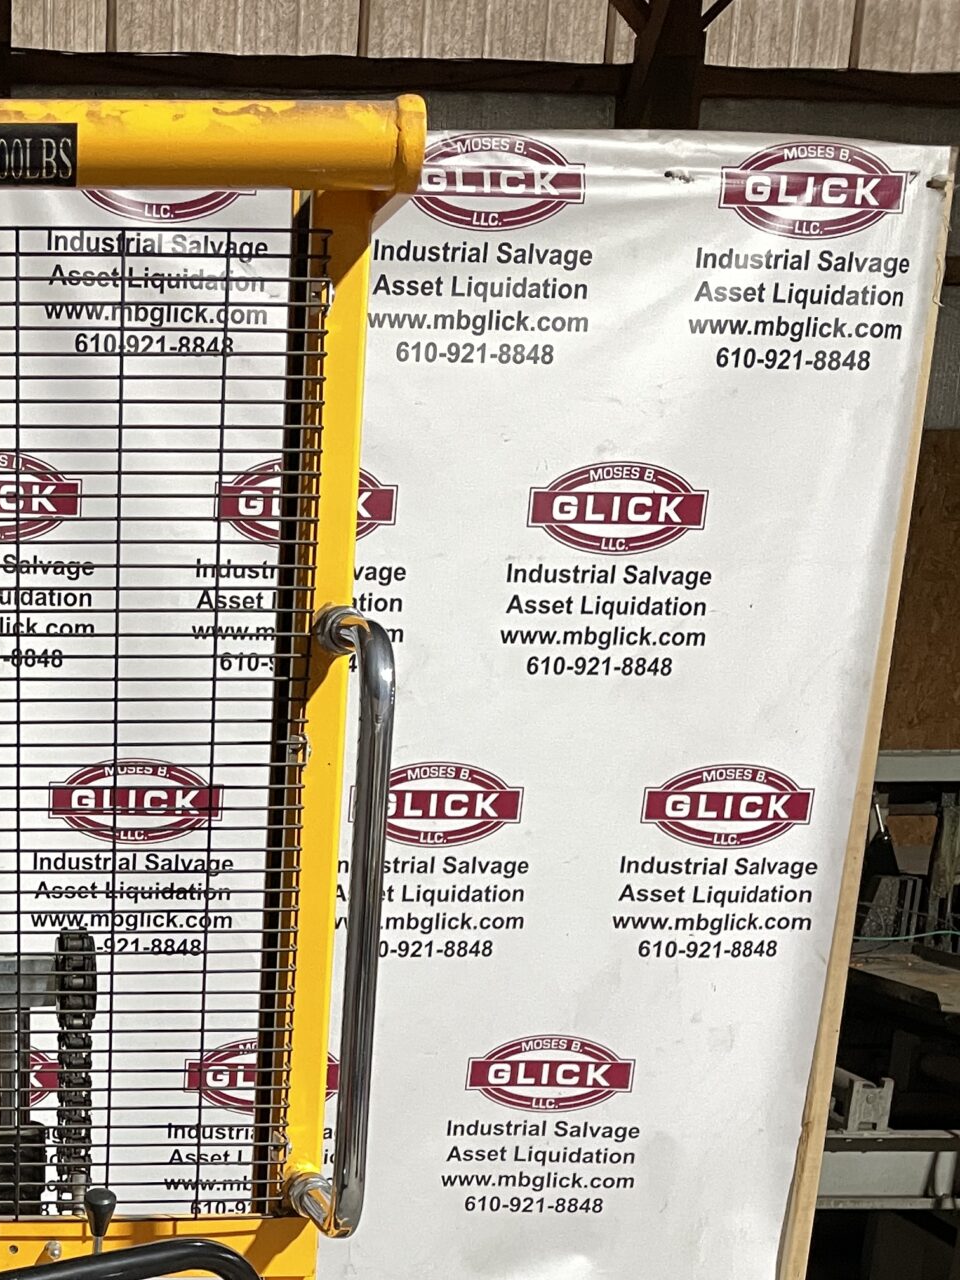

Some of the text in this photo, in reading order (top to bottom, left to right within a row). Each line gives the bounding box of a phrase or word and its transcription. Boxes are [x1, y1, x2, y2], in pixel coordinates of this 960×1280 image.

[458, 137, 510, 152] MOSES
[783, 146, 835, 161] MOSES
[420, 167, 559, 197] GLICK
[744, 175, 881, 206] GLICK
[144, 204, 174, 217] LLC.
[472, 213, 501, 226] LLC.
[794, 221, 823, 234] LLC.
[373, 240, 592, 271] Industrial Salvage
[696, 248, 909, 278] Industrial Salvage
[373, 274, 587, 302] Asset Liquidation
[695, 281, 903, 309] Asset Liquidation
[368, 310, 588, 336] www.mbglick.com
[689, 316, 902, 342] www.mbglick.com
[397, 342, 553, 364] 610-921-8848
[717, 347, 870, 370] 610-921-8848
[590, 467, 639, 481] MOSES
[552, 495, 684, 523] GLICK
[600, 538, 628, 550] LLC.
[507, 563, 711, 590] Industrial Salvage
[506, 595, 706, 620] Asset Liquidation
[501, 626, 705, 650] www.mbglick.com
[527, 656, 672, 676] 610-921-8848
[407, 767, 455, 780] MOSES
[703, 769, 751, 781] MOSES
[71, 789, 199, 815] GLICK
[666, 793, 792, 820] GLICK
[420, 832, 447, 842] LLC.
[712, 833, 739, 844] LLC.
[443, 856, 528, 878] Salvage
[620, 856, 817, 879] Industrial Salvage
[402, 885, 524, 906] Liquidation
[618, 884, 812, 907] Asset Liquidation
[613, 913, 811, 935] www.mbglick.com
[639, 940, 777, 958] 610-921-8848
[520, 1040, 567, 1052] MOSES
[485, 1063, 611, 1086] GLICK
[532, 1099, 558, 1108] LLC.
[447, 1120, 639, 1142] Industrial Salvage
[446, 1146, 635, 1166] Asset Liquidation
[441, 1171, 634, 1192] www.mbglick.com
[465, 1196, 603, 1213] 610-921-8848
